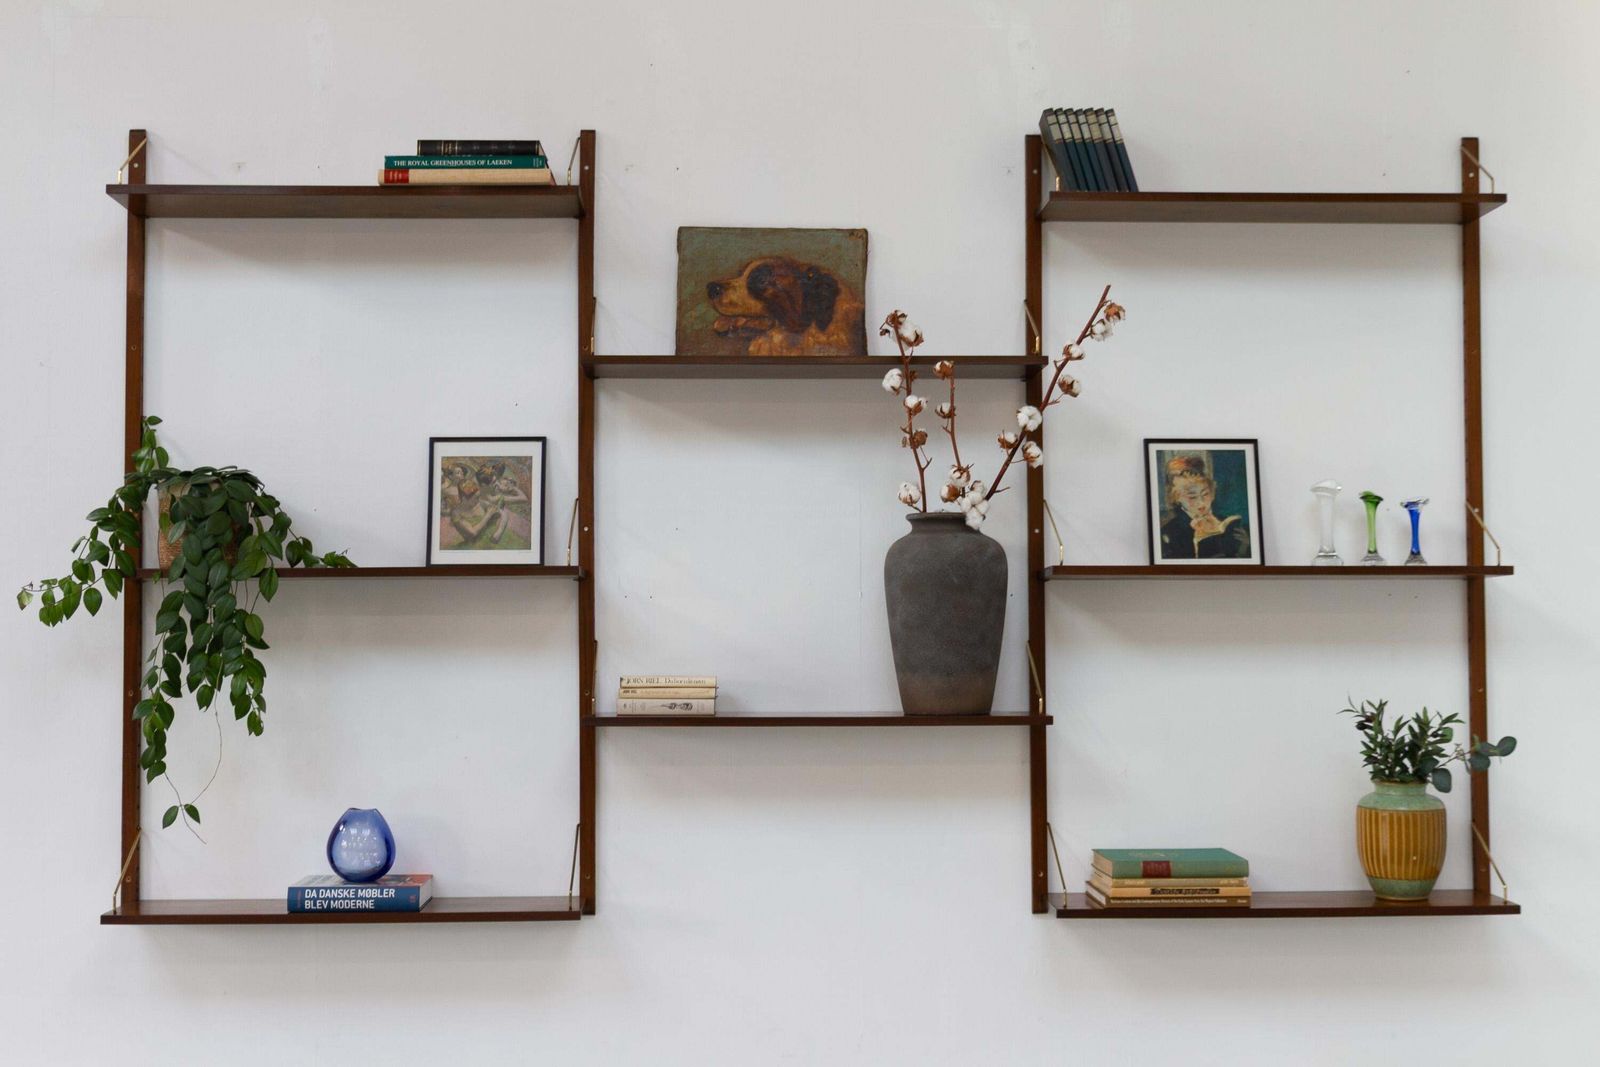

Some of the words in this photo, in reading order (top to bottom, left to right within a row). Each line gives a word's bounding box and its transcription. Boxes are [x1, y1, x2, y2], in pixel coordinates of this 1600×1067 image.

[305, 889, 317, 898] DA
[319, 889, 355, 898] DANSKE
[357, 888, 395, 898] MØBLER
[305, 900, 328, 909] BLEV
[330, 899, 374, 909] MODERNE
